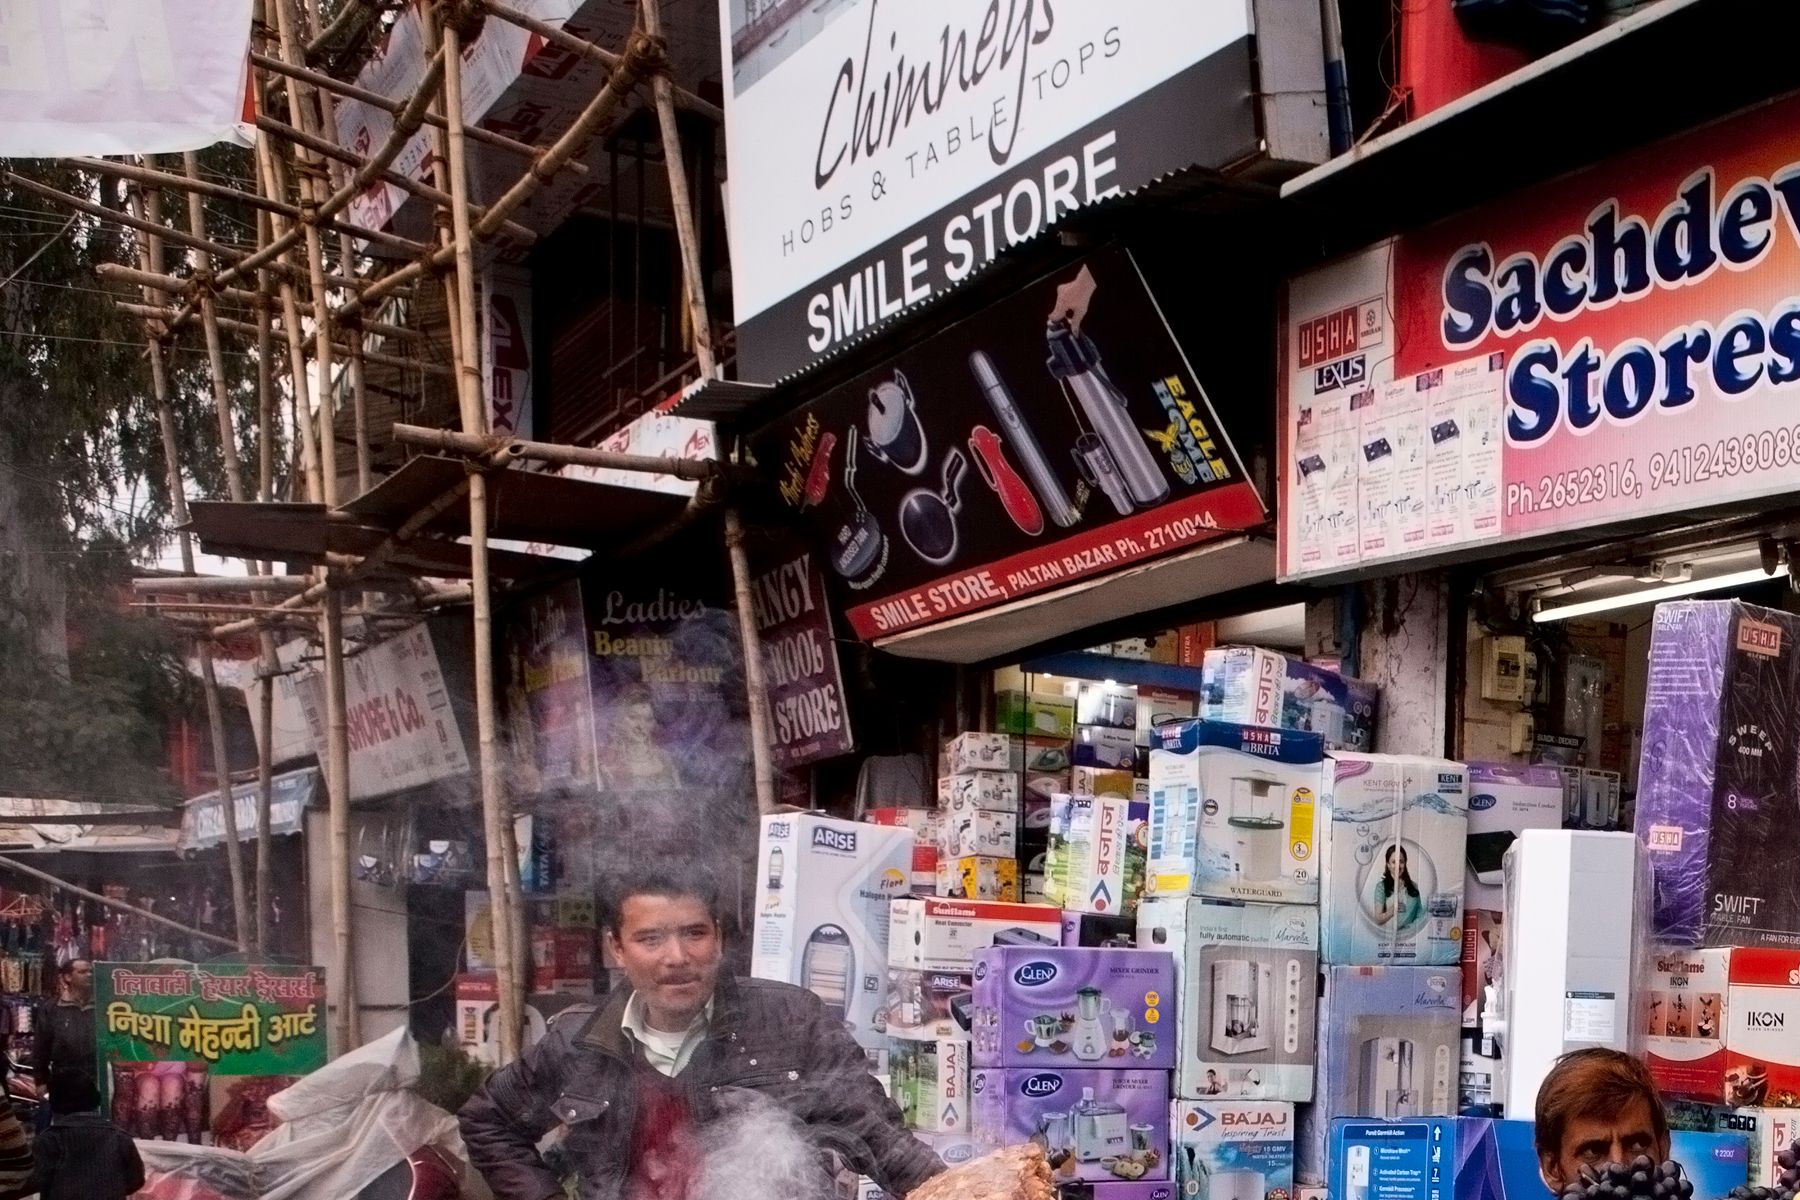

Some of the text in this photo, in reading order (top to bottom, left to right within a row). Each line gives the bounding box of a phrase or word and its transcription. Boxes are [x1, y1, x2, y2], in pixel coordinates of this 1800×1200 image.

[814, 0, 1055, 191] Chimneys
[781, 25, 1124, 258] HOBS & TABLE TOPS
[805, 129, 1121, 353] SMILE STORE
[1300, 311, 1357, 362] USHA
[490, 304, 514, 431] ALEX
[1315, 357, 1364, 390] LEXUS
[1151, 378, 1217, 484] HOME
[1165, 374, 1231, 481] EAGLE
[870, 509, 1219, 631] SMILE STORE, PALTAN BAZAR Ph. 2710044
[750, 553, 816, 631] ANCY
[601, 587, 708, 626] Ladies
[1656, 607, 1692, 623] SWIFT
[1743, 627, 1776, 648] USHA
[769, 628, 825, 687] WOOL
[640, 656, 724, 684] Parlour
[1255, 655, 1274, 724] बजाज
[776, 683, 841, 745] STORE
[1243, 730, 1269, 743] USHA
[1728, 725, 1773, 752] SWEEP
[1250, 743, 1280, 756] BRITA
[1738, 746, 1763, 757] 400 MM
[1440, 774, 1460, 783] KENT
[1727, 795, 1737, 809] 8
[813, 828, 857, 850] ARISE
[1100, 802, 1114, 875] बजाज
[1652, 831, 1678, 845] USHA
[1296, 871, 1307, 879] 20
[1230, 886, 1283, 898] WATERGUARD
[933, 904, 976, 917] Sunflame
[1714, 894, 1761, 915] SWIFT
[1737, 914, 1751, 924] FAN
[1199, 931, 1250, 942] fully automatic
[1766, 934, 1777, 944] FAN
[1778, 935, 1789, 945] FOR
[933, 977, 960, 988] ARISE
[1021, 965, 1052, 981] GLEN
[1670, 977, 1689, 987] IKON
[106, 1001, 172, 1046] निशा
[267, 1004, 318, 1044] आर्ट
[1748, 1011, 1784, 1027] IKON
[945, 1043, 956, 1098] BAJAJ
[1027, 1078, 1057, 1092] GLEN
[1221, 1111, 1288, 1127] BAJAJ
[1221, 1127, 1287, 1139] Inspiring Trust
